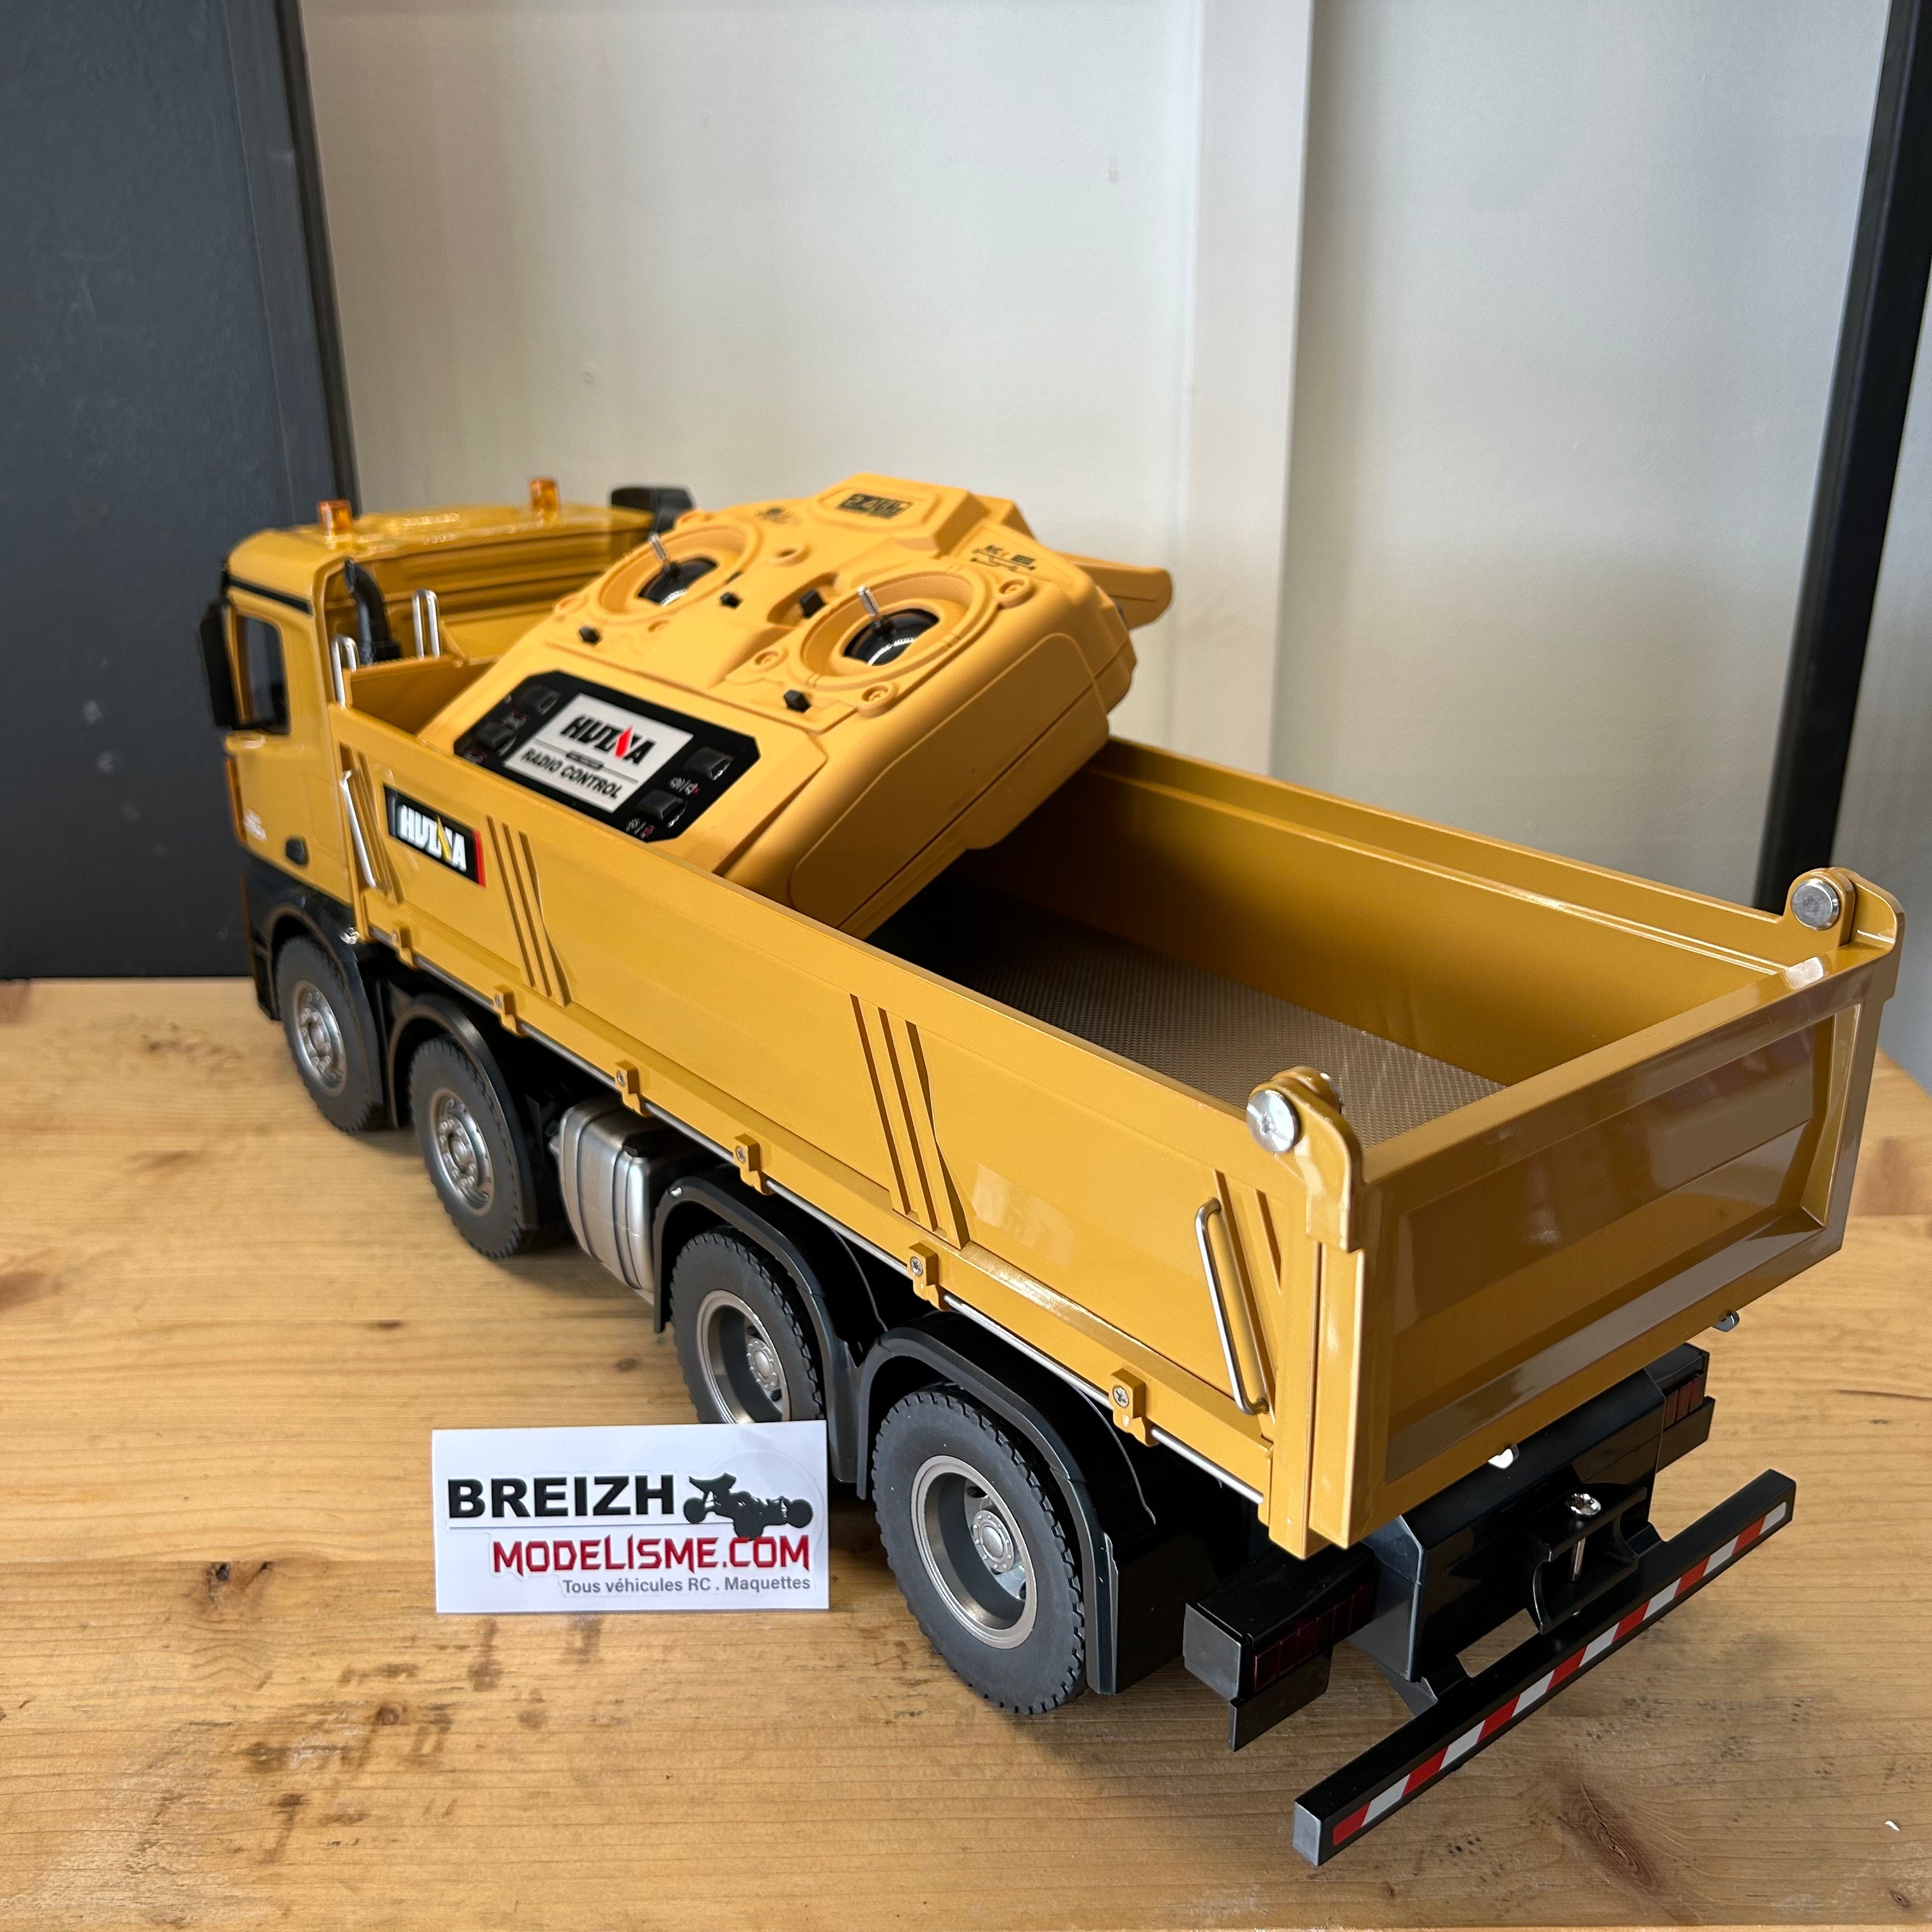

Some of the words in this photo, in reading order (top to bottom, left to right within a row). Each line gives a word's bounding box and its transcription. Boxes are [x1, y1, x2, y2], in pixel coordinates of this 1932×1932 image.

[521, 747, 564, 773] RADIO
[560, 764, 624, 799] CONTROL
[448, 1475, 674, 1518] BREIZH
[493, 1534, 810, 1577] MODELISME.COM
[563, 1579, 601, 1593] Tous
[606, 1577, 682, 1593] véhicules
[688, 1577, 710, 1591] RC
[725, 1576, 811, 1593] Maquettes
